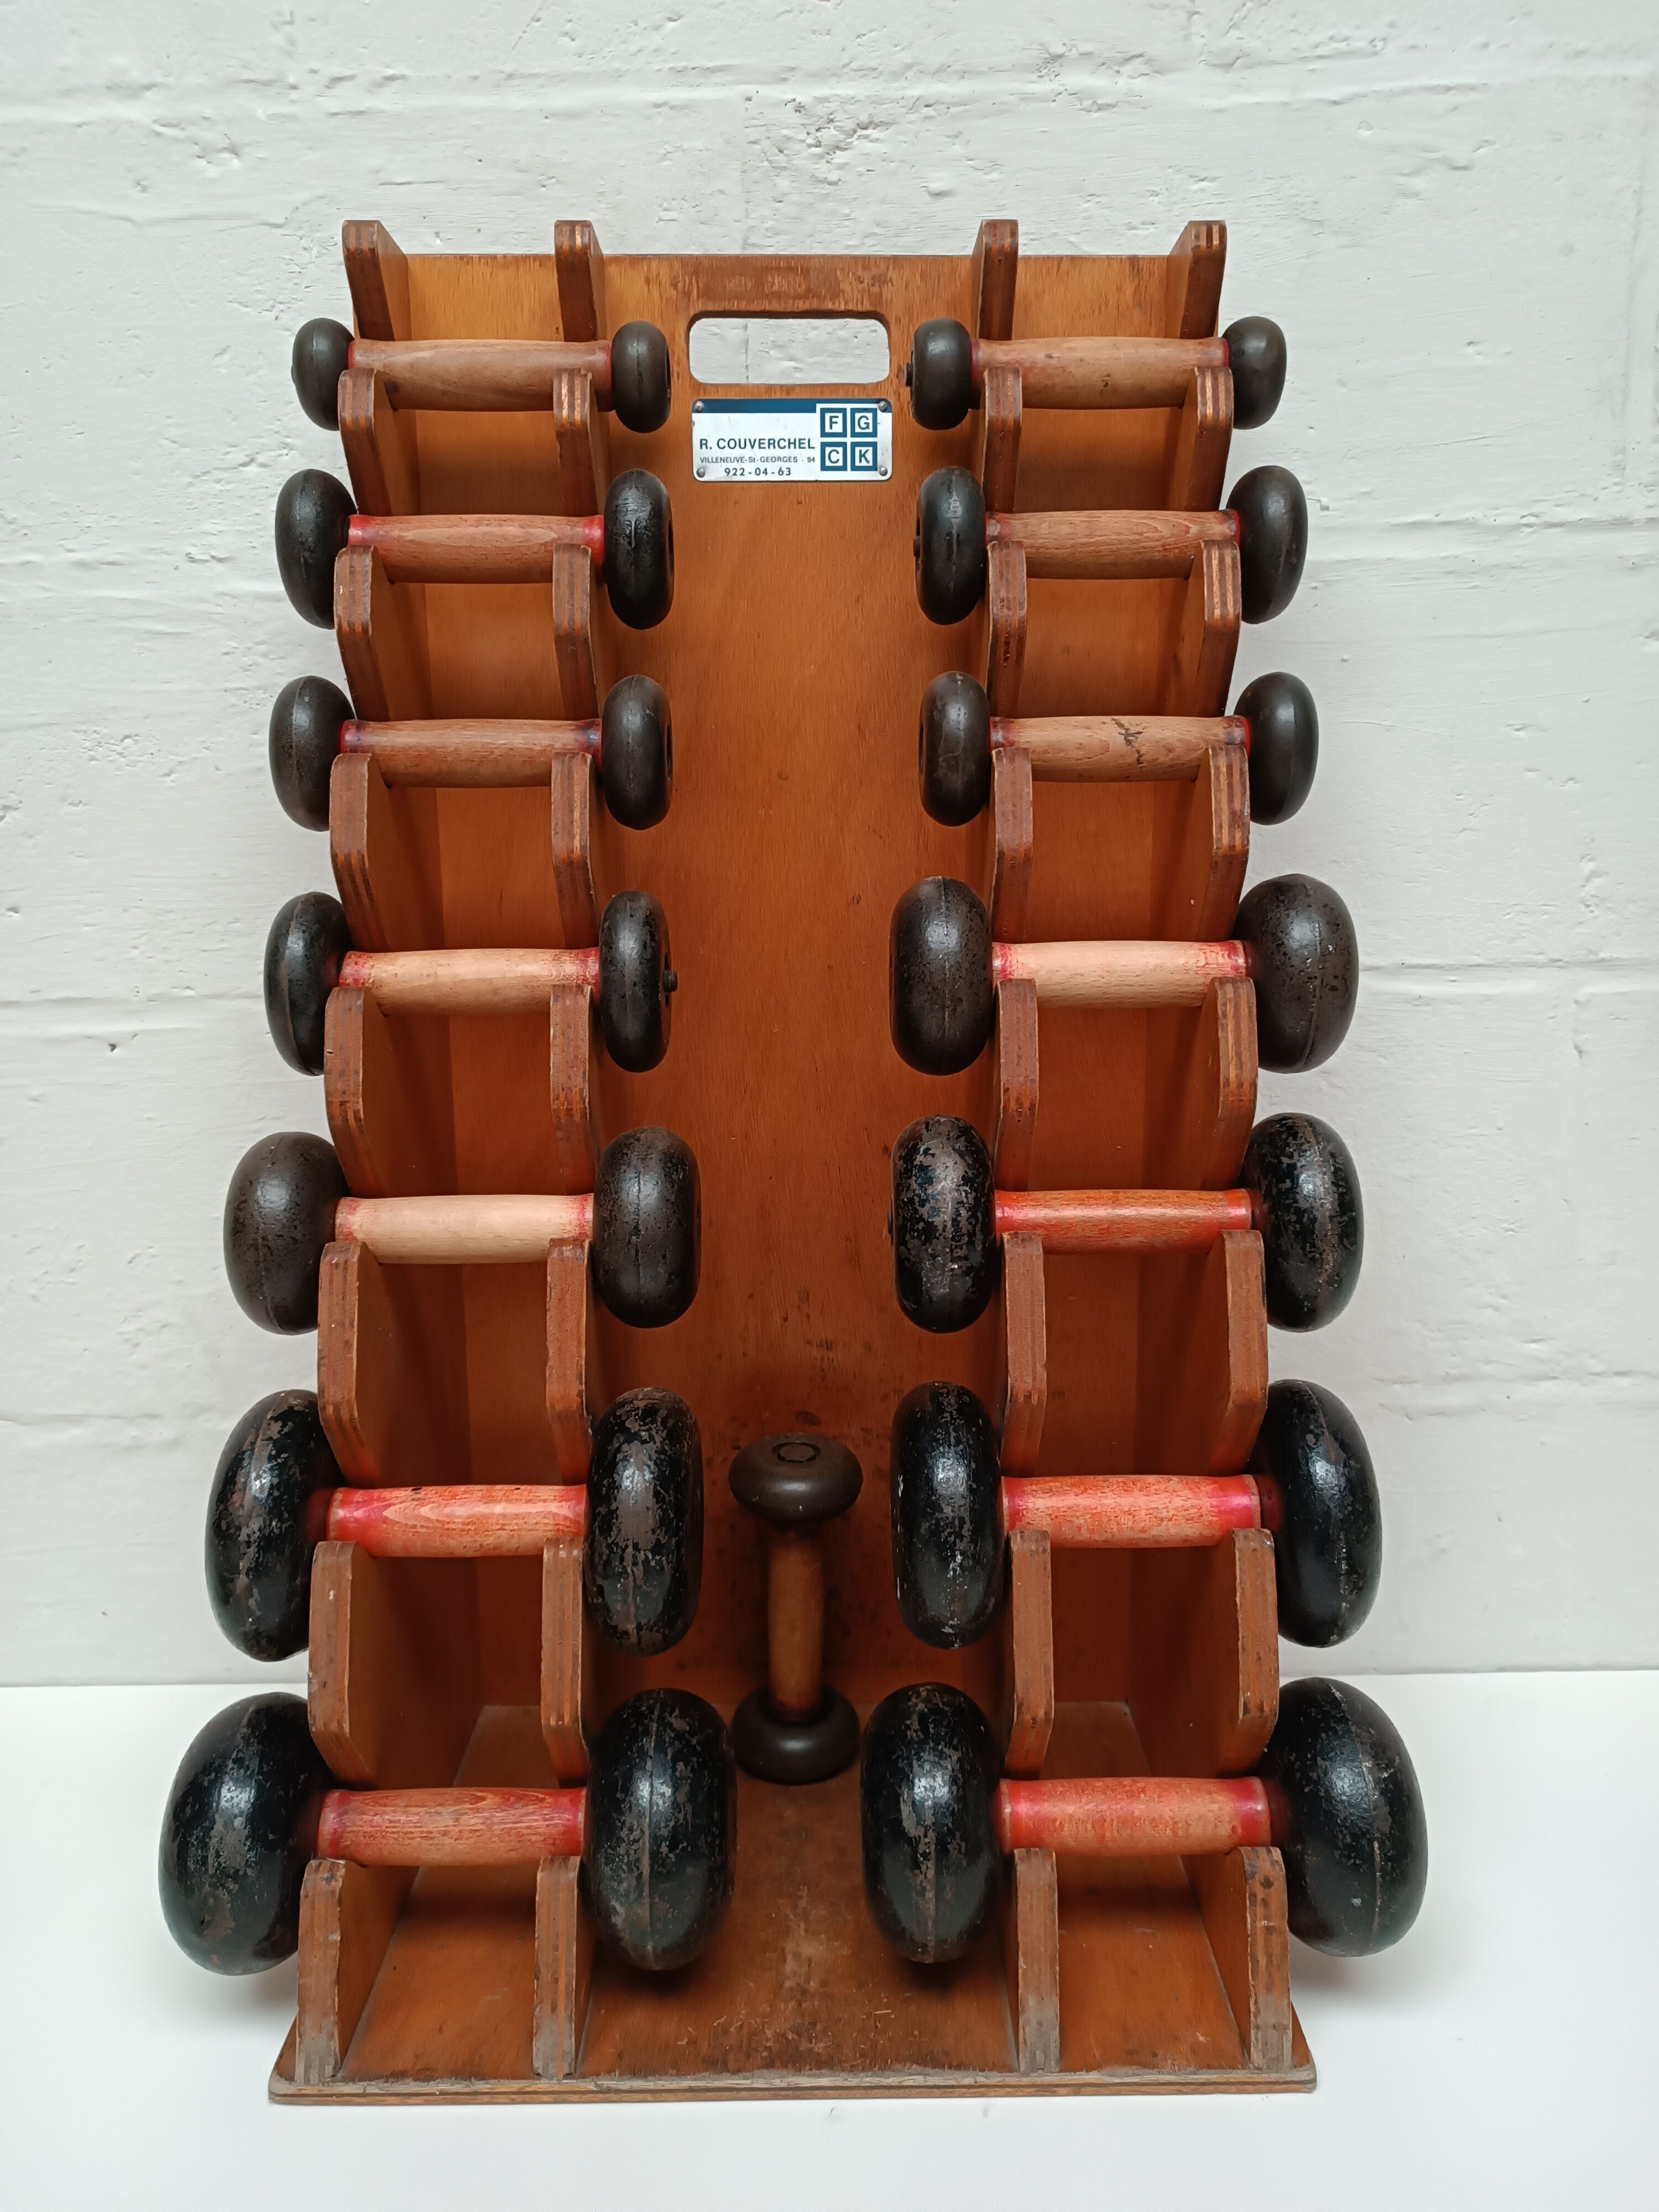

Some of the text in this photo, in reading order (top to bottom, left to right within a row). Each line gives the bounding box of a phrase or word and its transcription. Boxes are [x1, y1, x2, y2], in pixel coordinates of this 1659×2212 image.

[830, 415, 870, 430] F G
[700, 438, 815, 450] R. COUVERCHEL
[828, 449, 870, 464] C K
